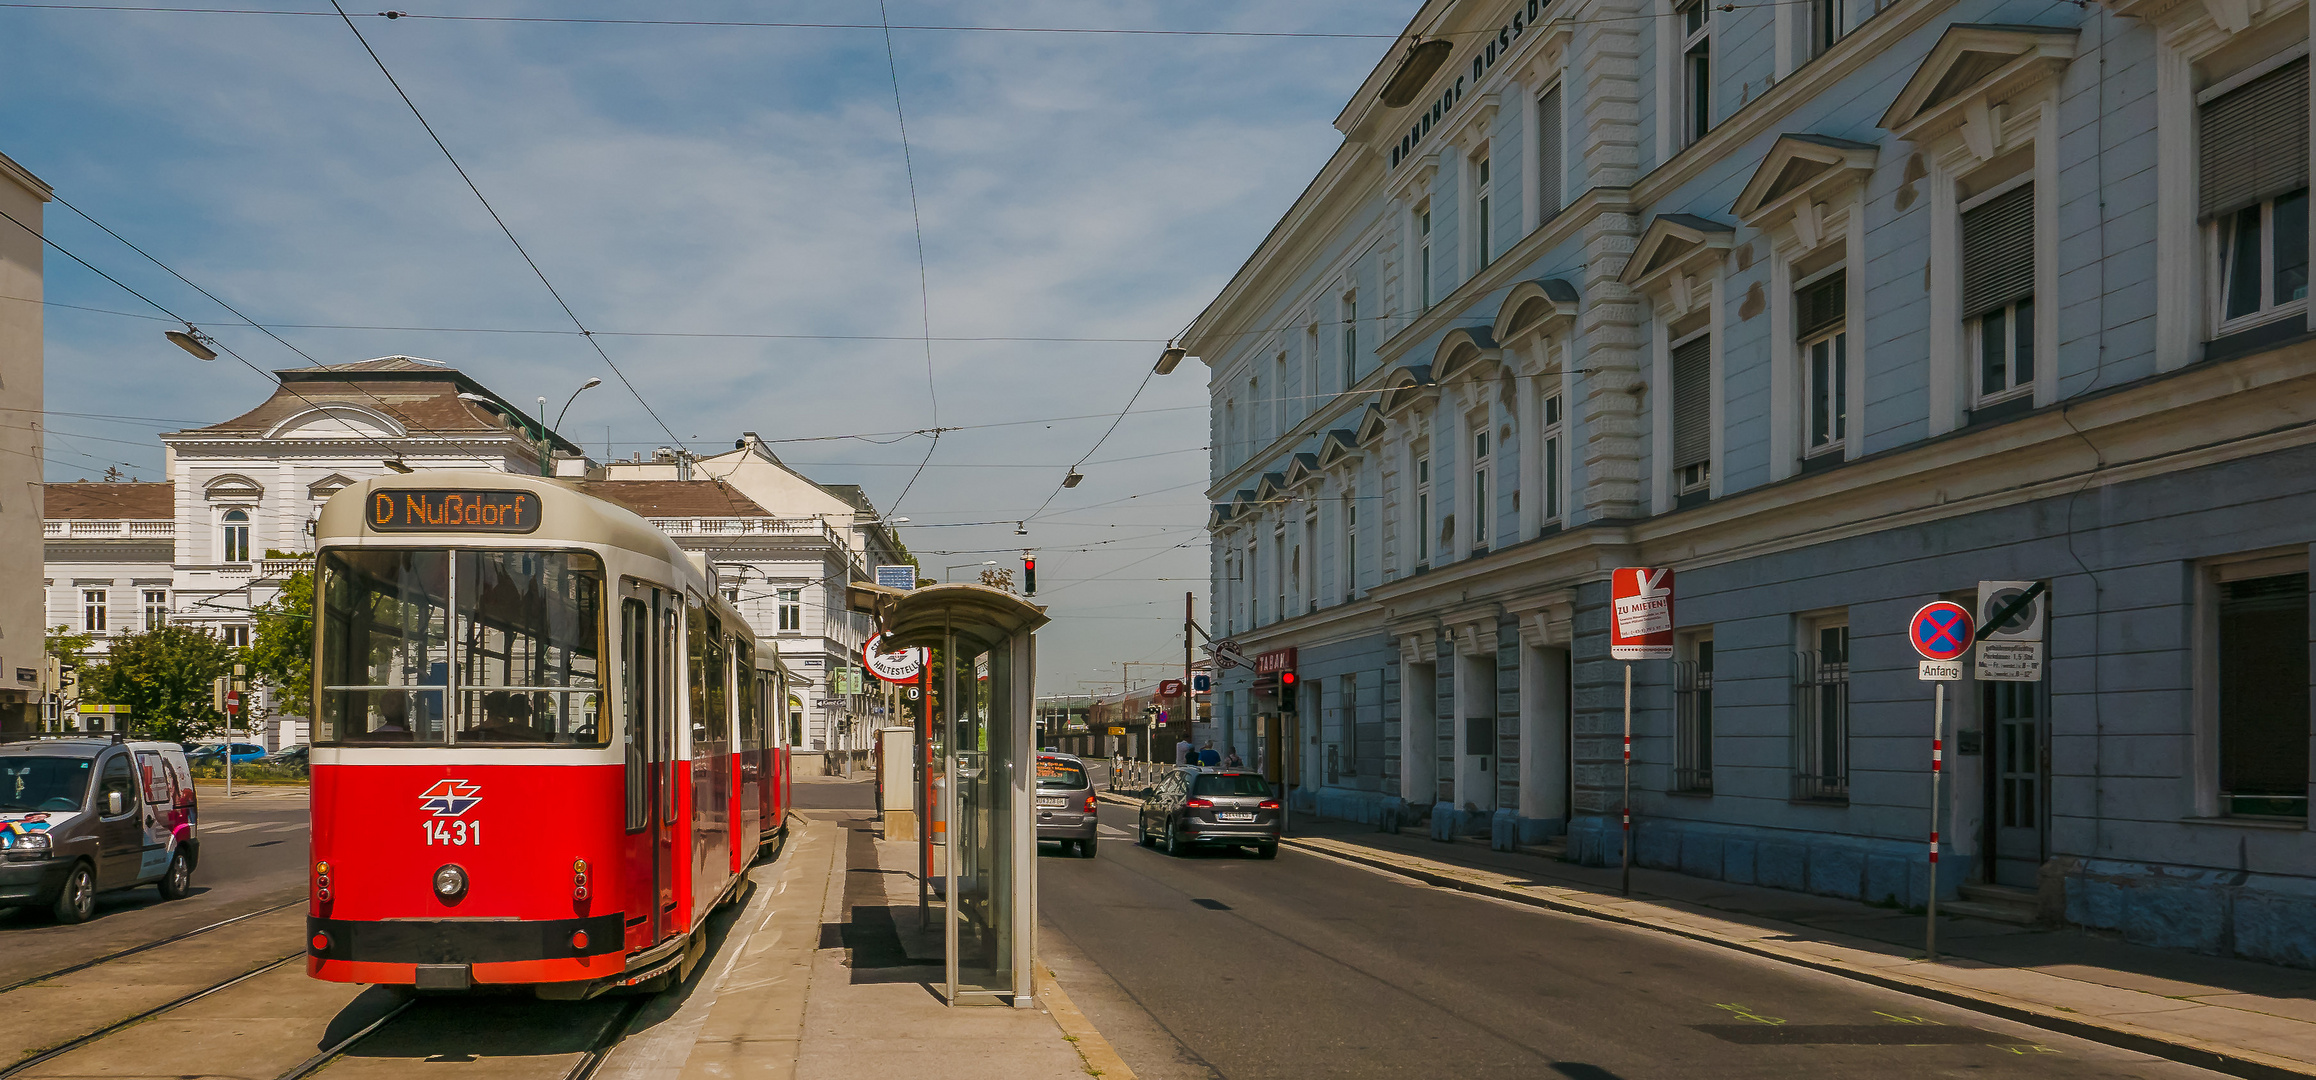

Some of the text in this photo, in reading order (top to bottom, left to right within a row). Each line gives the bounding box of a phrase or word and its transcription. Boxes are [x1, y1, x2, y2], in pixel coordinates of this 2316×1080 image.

[1392, 0, 1552, 169] BAHNHOF NUSSD
[376, 493, 525, 525] D Nußdorf
[1618, 599, 1666, 615] ZU MIETEN!
[873, 659, 920, 676] HALTESTELLE
[1260, 653, 1285, 672] TABAK
[1924, 665, 1958, 679] Anfang
[909, 688, 919, 699] D
[422, 820, 480, 846] 1431
